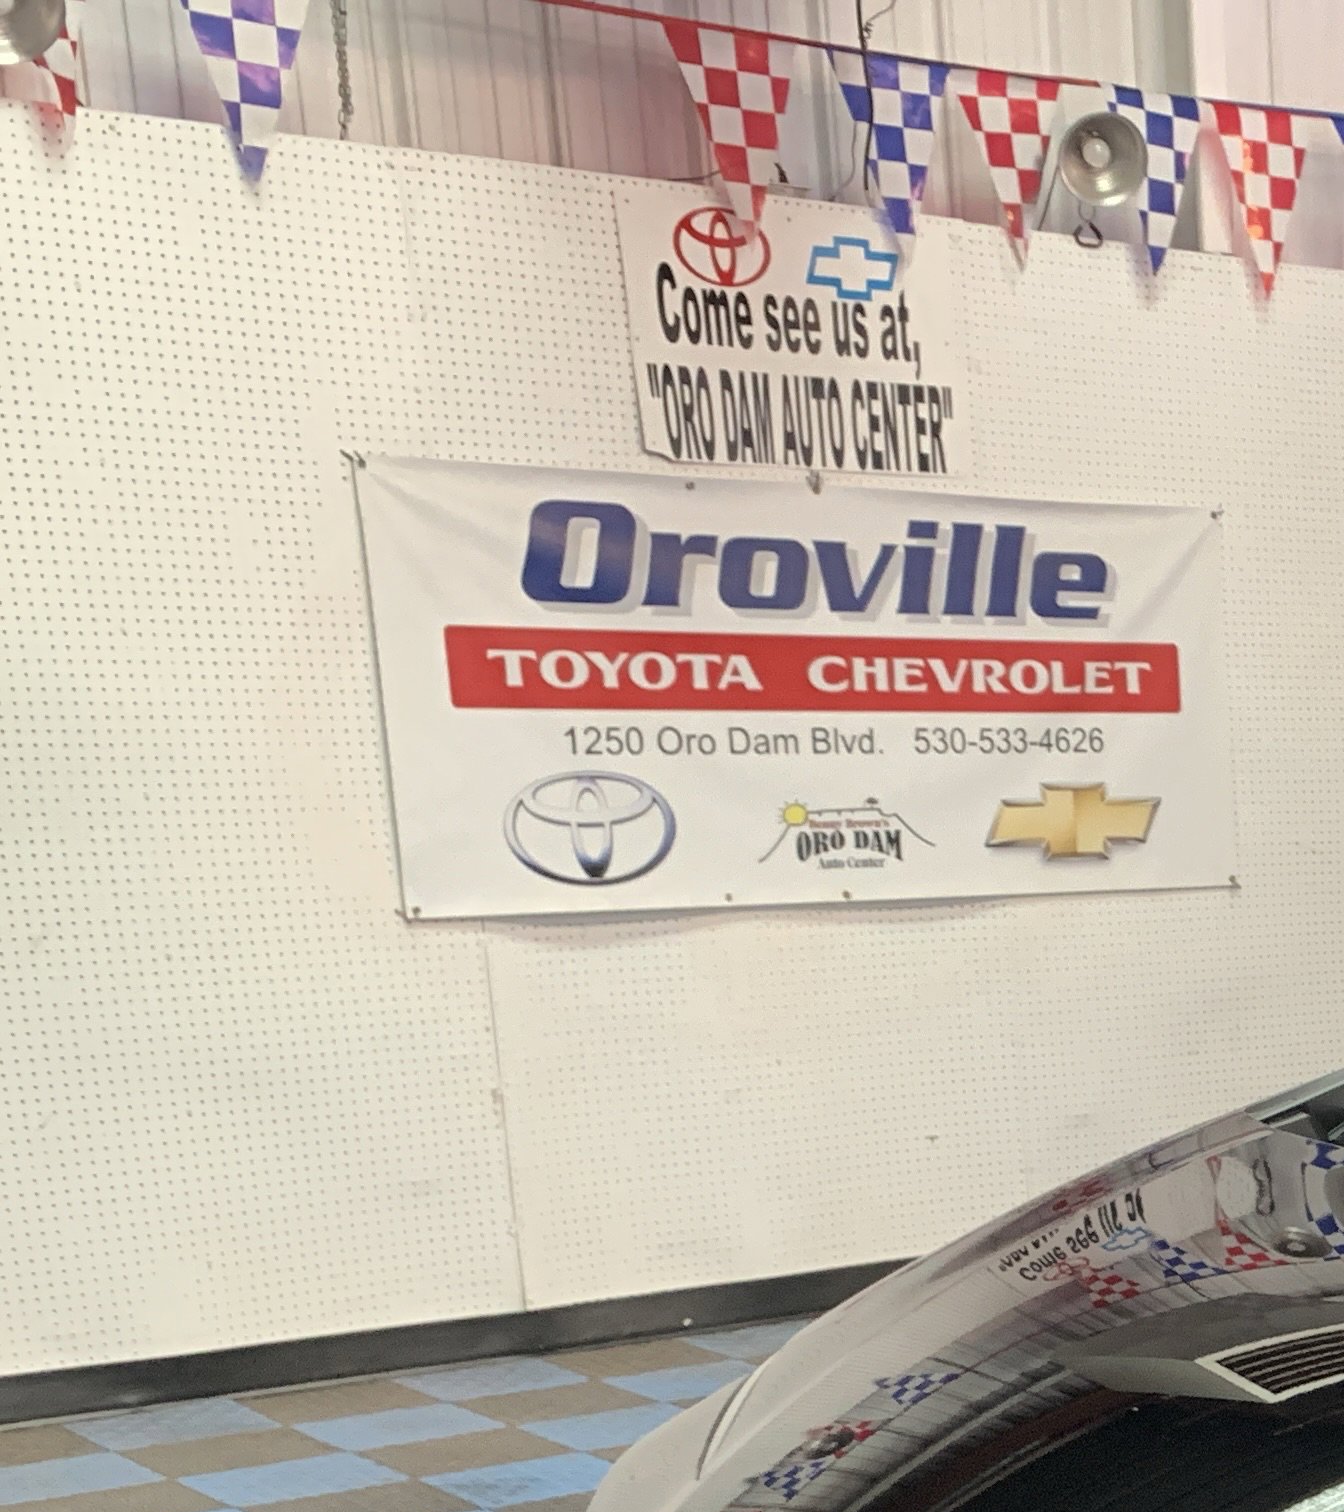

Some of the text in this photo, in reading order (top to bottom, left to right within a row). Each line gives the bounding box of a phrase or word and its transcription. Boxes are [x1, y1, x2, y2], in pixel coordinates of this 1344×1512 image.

[657, 261, 921, 380] Come see us at,
[647, 363, 954, 474] "ORO DAM AUTO CENTER"
[520, 499, 1108, 620] Oroville
[486, 648, 1152, 695] TOYOTA CHEVROLET
[564, 726, 885, 756] 1250 Oro Dam Blvd.
[913, 727, 1105, 755] 530-533-4626
[796, 829, 903, 862] ORO DAM
